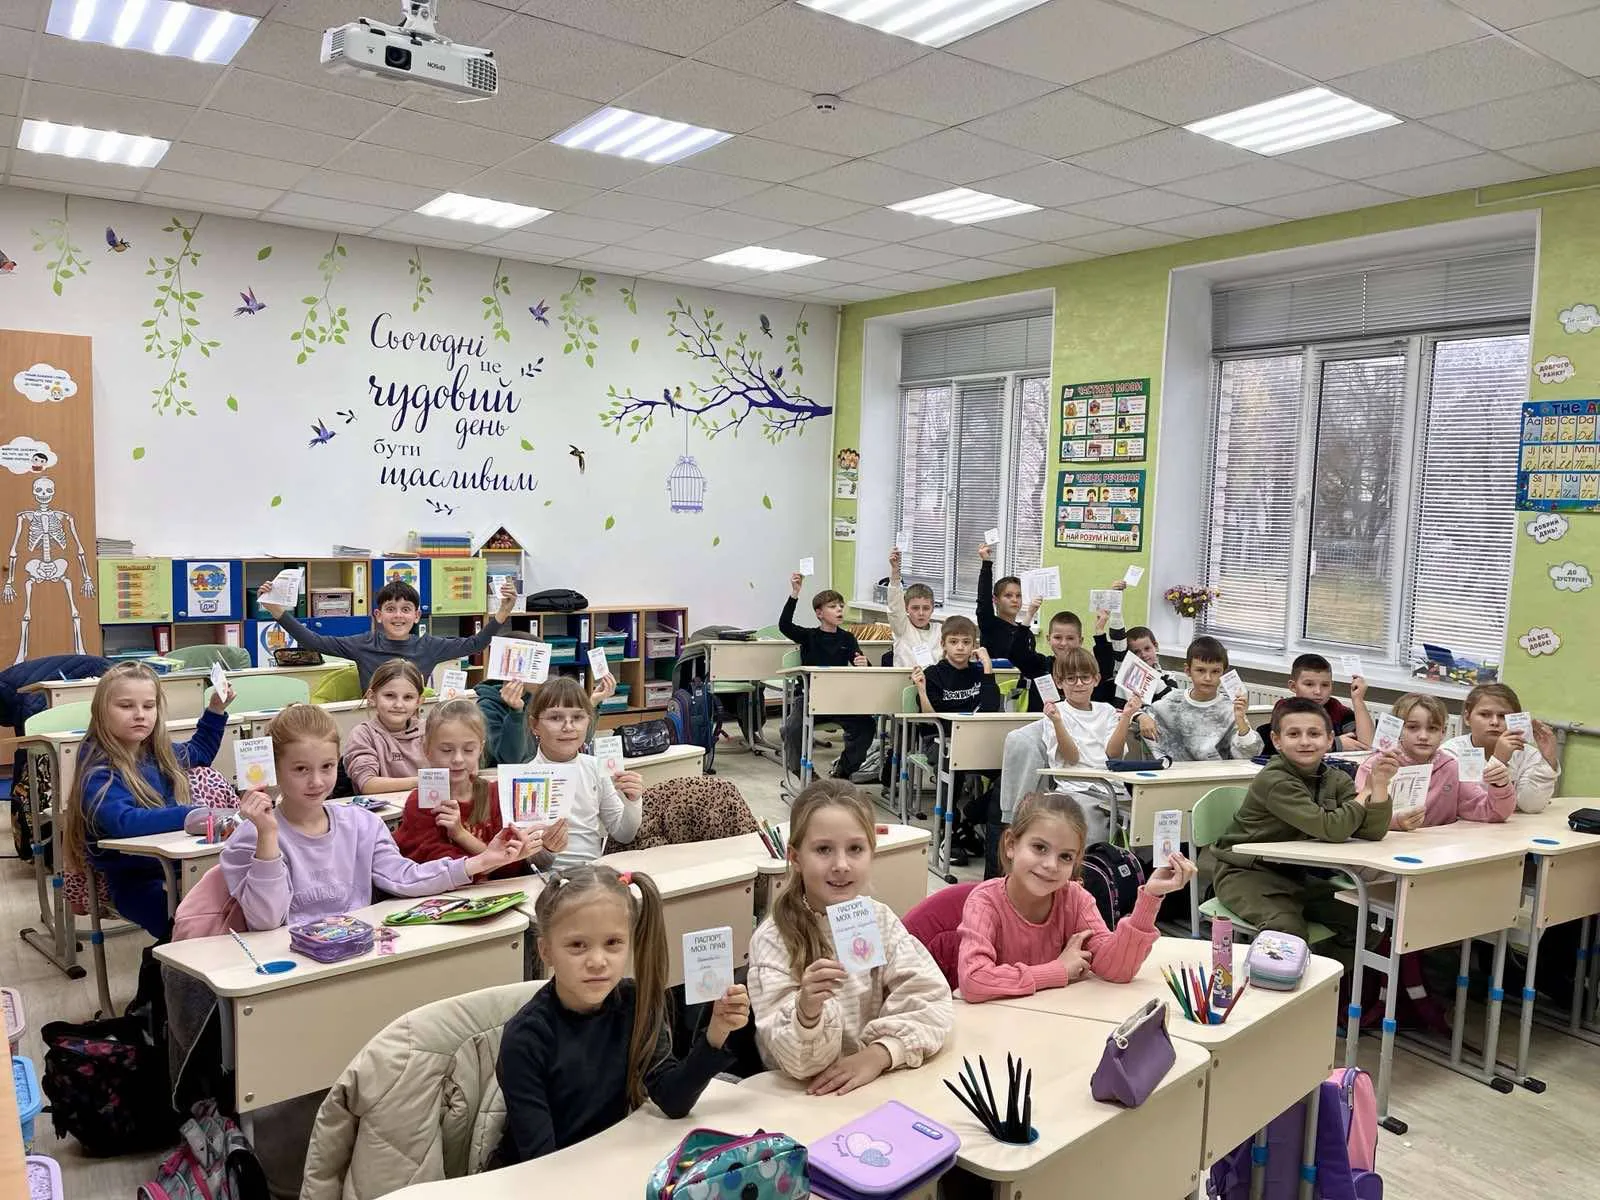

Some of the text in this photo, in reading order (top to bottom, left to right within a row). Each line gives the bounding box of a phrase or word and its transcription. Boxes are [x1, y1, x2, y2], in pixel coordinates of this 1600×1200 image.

[370, 312, 488, 371] Сьогодні
[480, 361, 502, 374] це
[1540, 362, 1569, 372] ДОБРОГО
[368, 364, 522, 433] чудовий
[1552, 403, 1580, 414] THE
[1526, 416, 1594, 425] Aa Bb Cc Dd
[455, 418, 510, 450] день
[373, 438, 421, 459] бути
[1575, 445, 1594, 453] Mm
[380, 457, 539, 492] щасливим
[1539, 527, 1558, 538] ДЕНЬ!
[1527, 633, 1549, 644] НА ВСЕ
[694, 933, 722, 944] ПАСПОРТ
